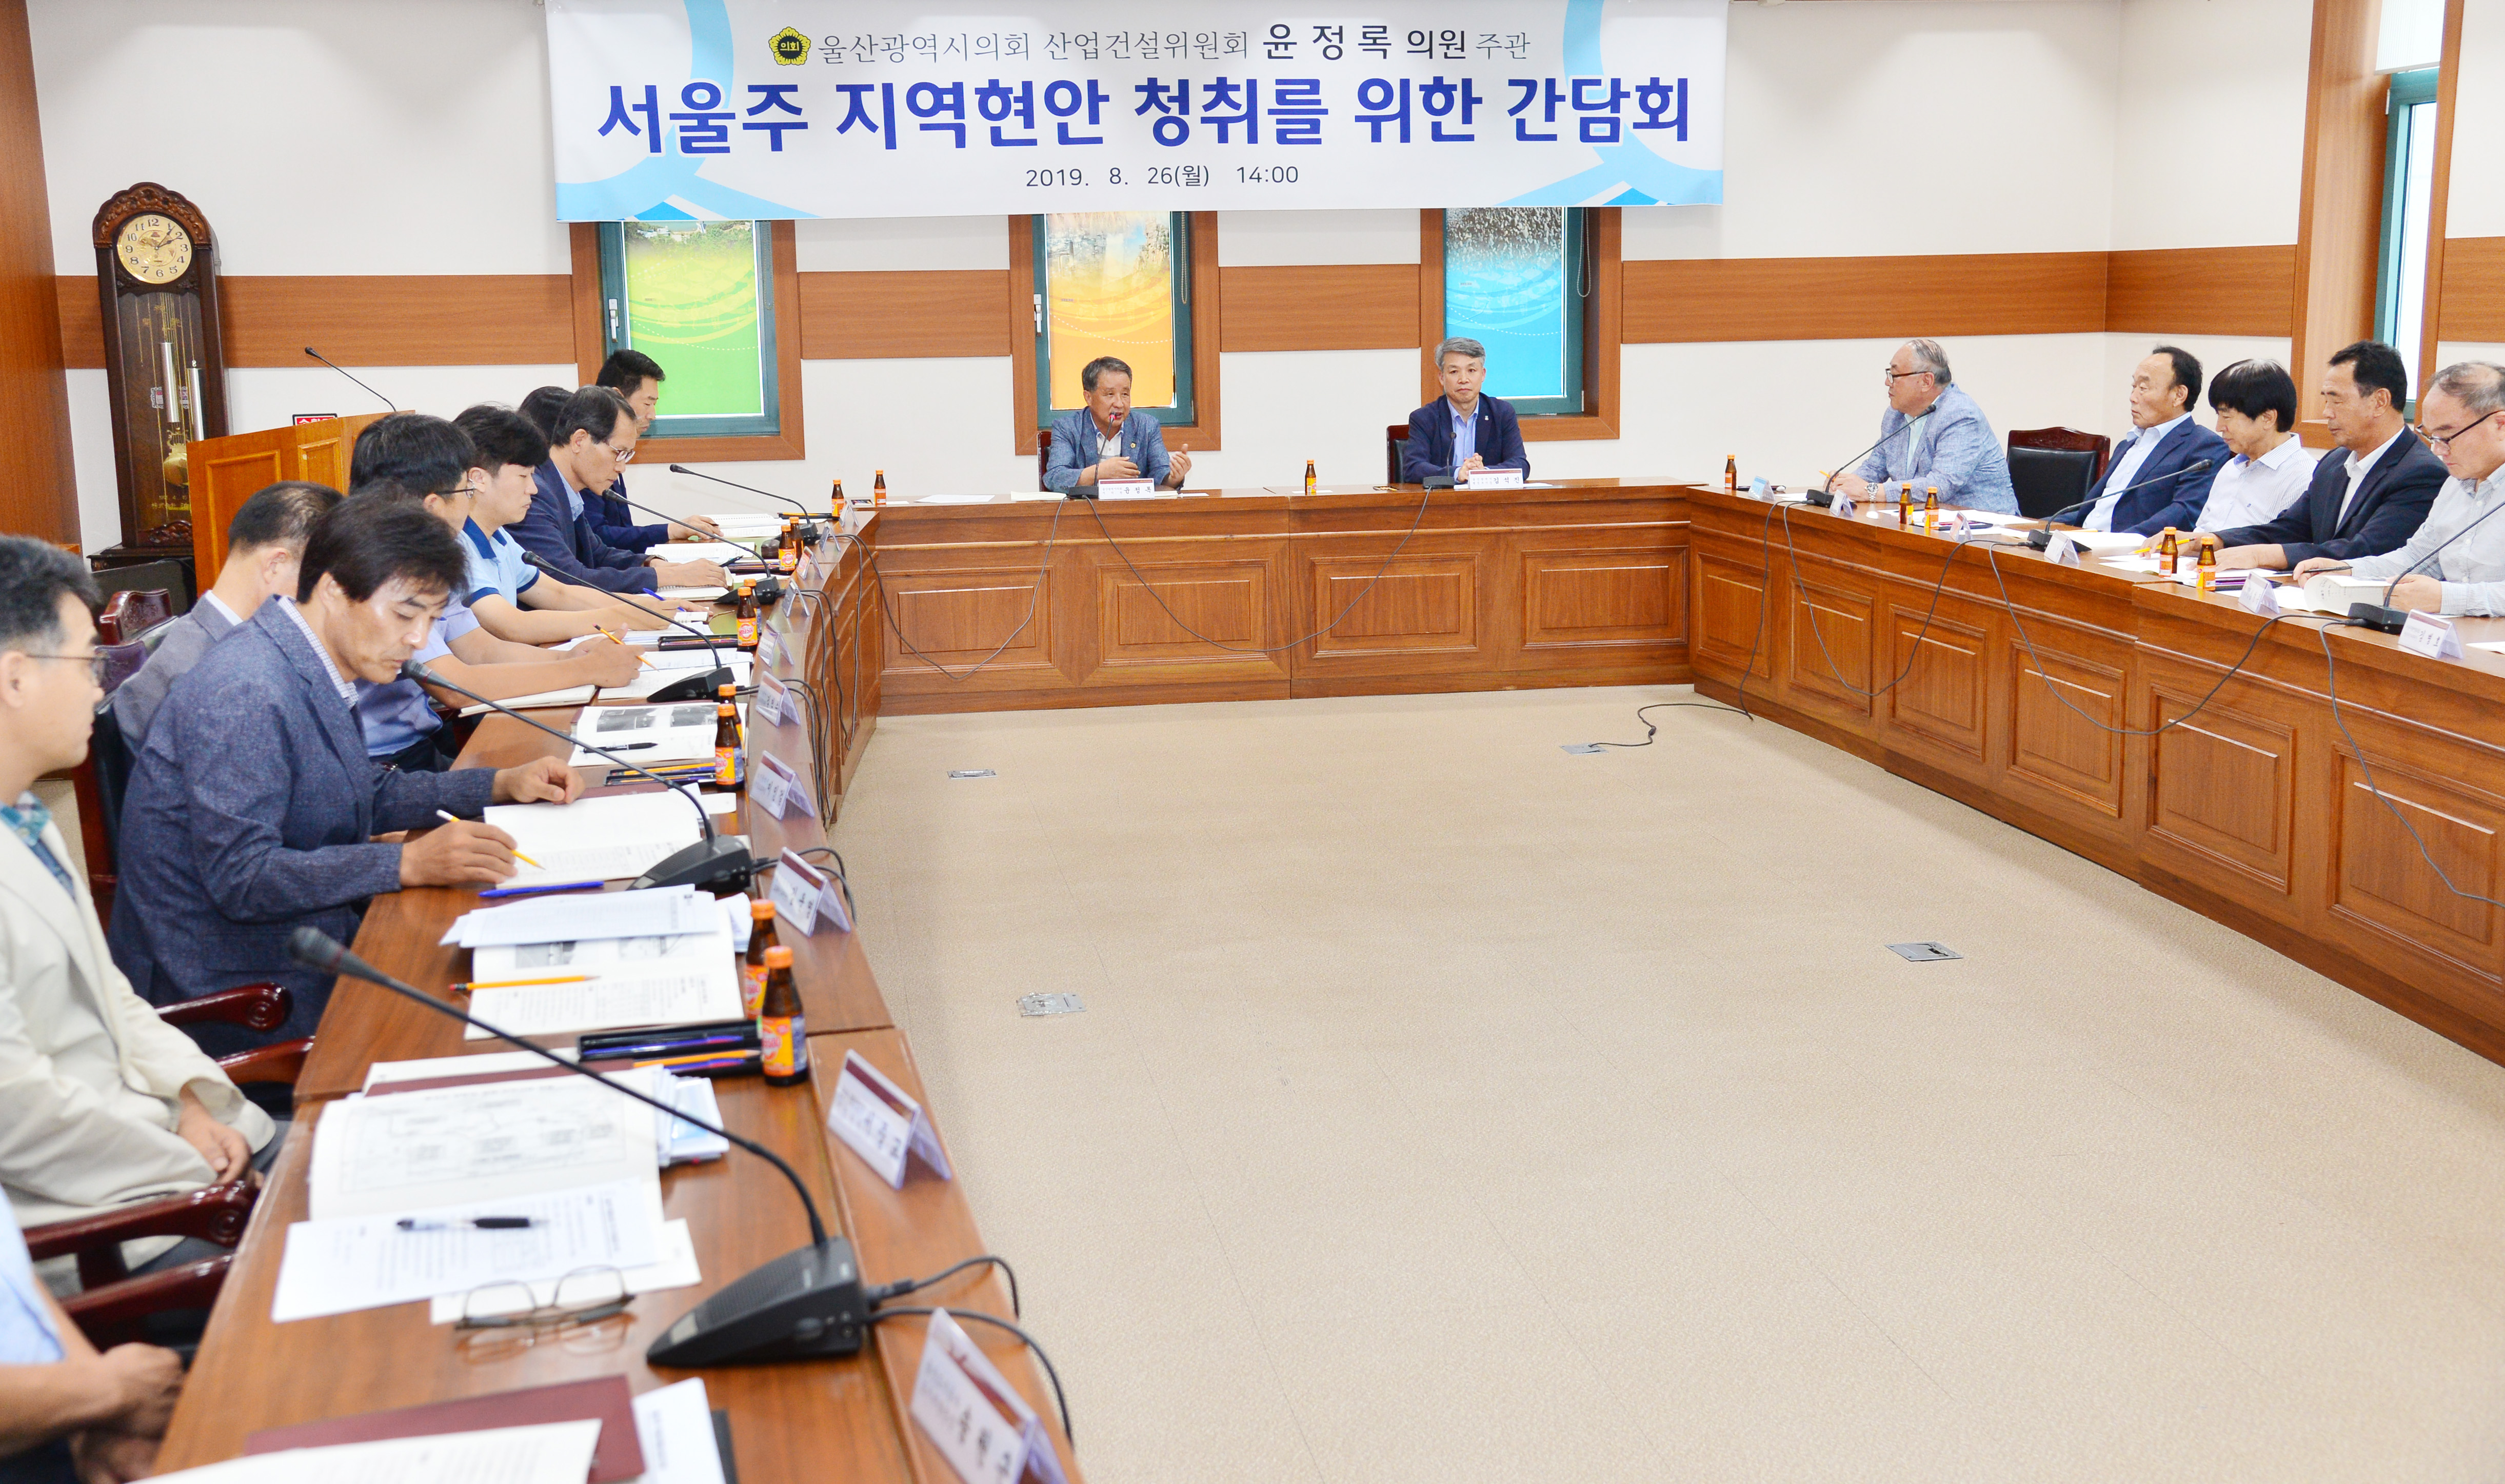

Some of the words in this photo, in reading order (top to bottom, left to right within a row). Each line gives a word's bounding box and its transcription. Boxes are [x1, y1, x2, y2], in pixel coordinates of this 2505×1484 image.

[780, 41, 800, 51] 의회
[818, 32, 1029, 64] 울산광역시의회
[1043, 31, 1247, 61] 산업건설위원회
[1263, 24, 1297, 59] 윤
[1313, 25, 1343, 61] 정
[1358, 25, 1392, 59] 록
[1406, 30, 1466, 59] 의원
[1475, 32, 1531, 60] 주관
[598, 82, 809, 154] 서울주
[836, 79, 1110, 150] 지역현안
[1134, 76, 1328, 147] 청취를
[1355, 76, 1483, 143] 위한
[1507, 77, 1688, 143] 간담회
[1026, 168, 1088, 187] 2019.
[1109, 167, 1128, 185] 8.
[1148, 165, 1209, 187] 26(월)
[1237, 166, 1298, 183] 14:00
[148, 218, 160, 227] 12
[156, 269, 164, 277] 6
[169, 266, 177, 274] 5
